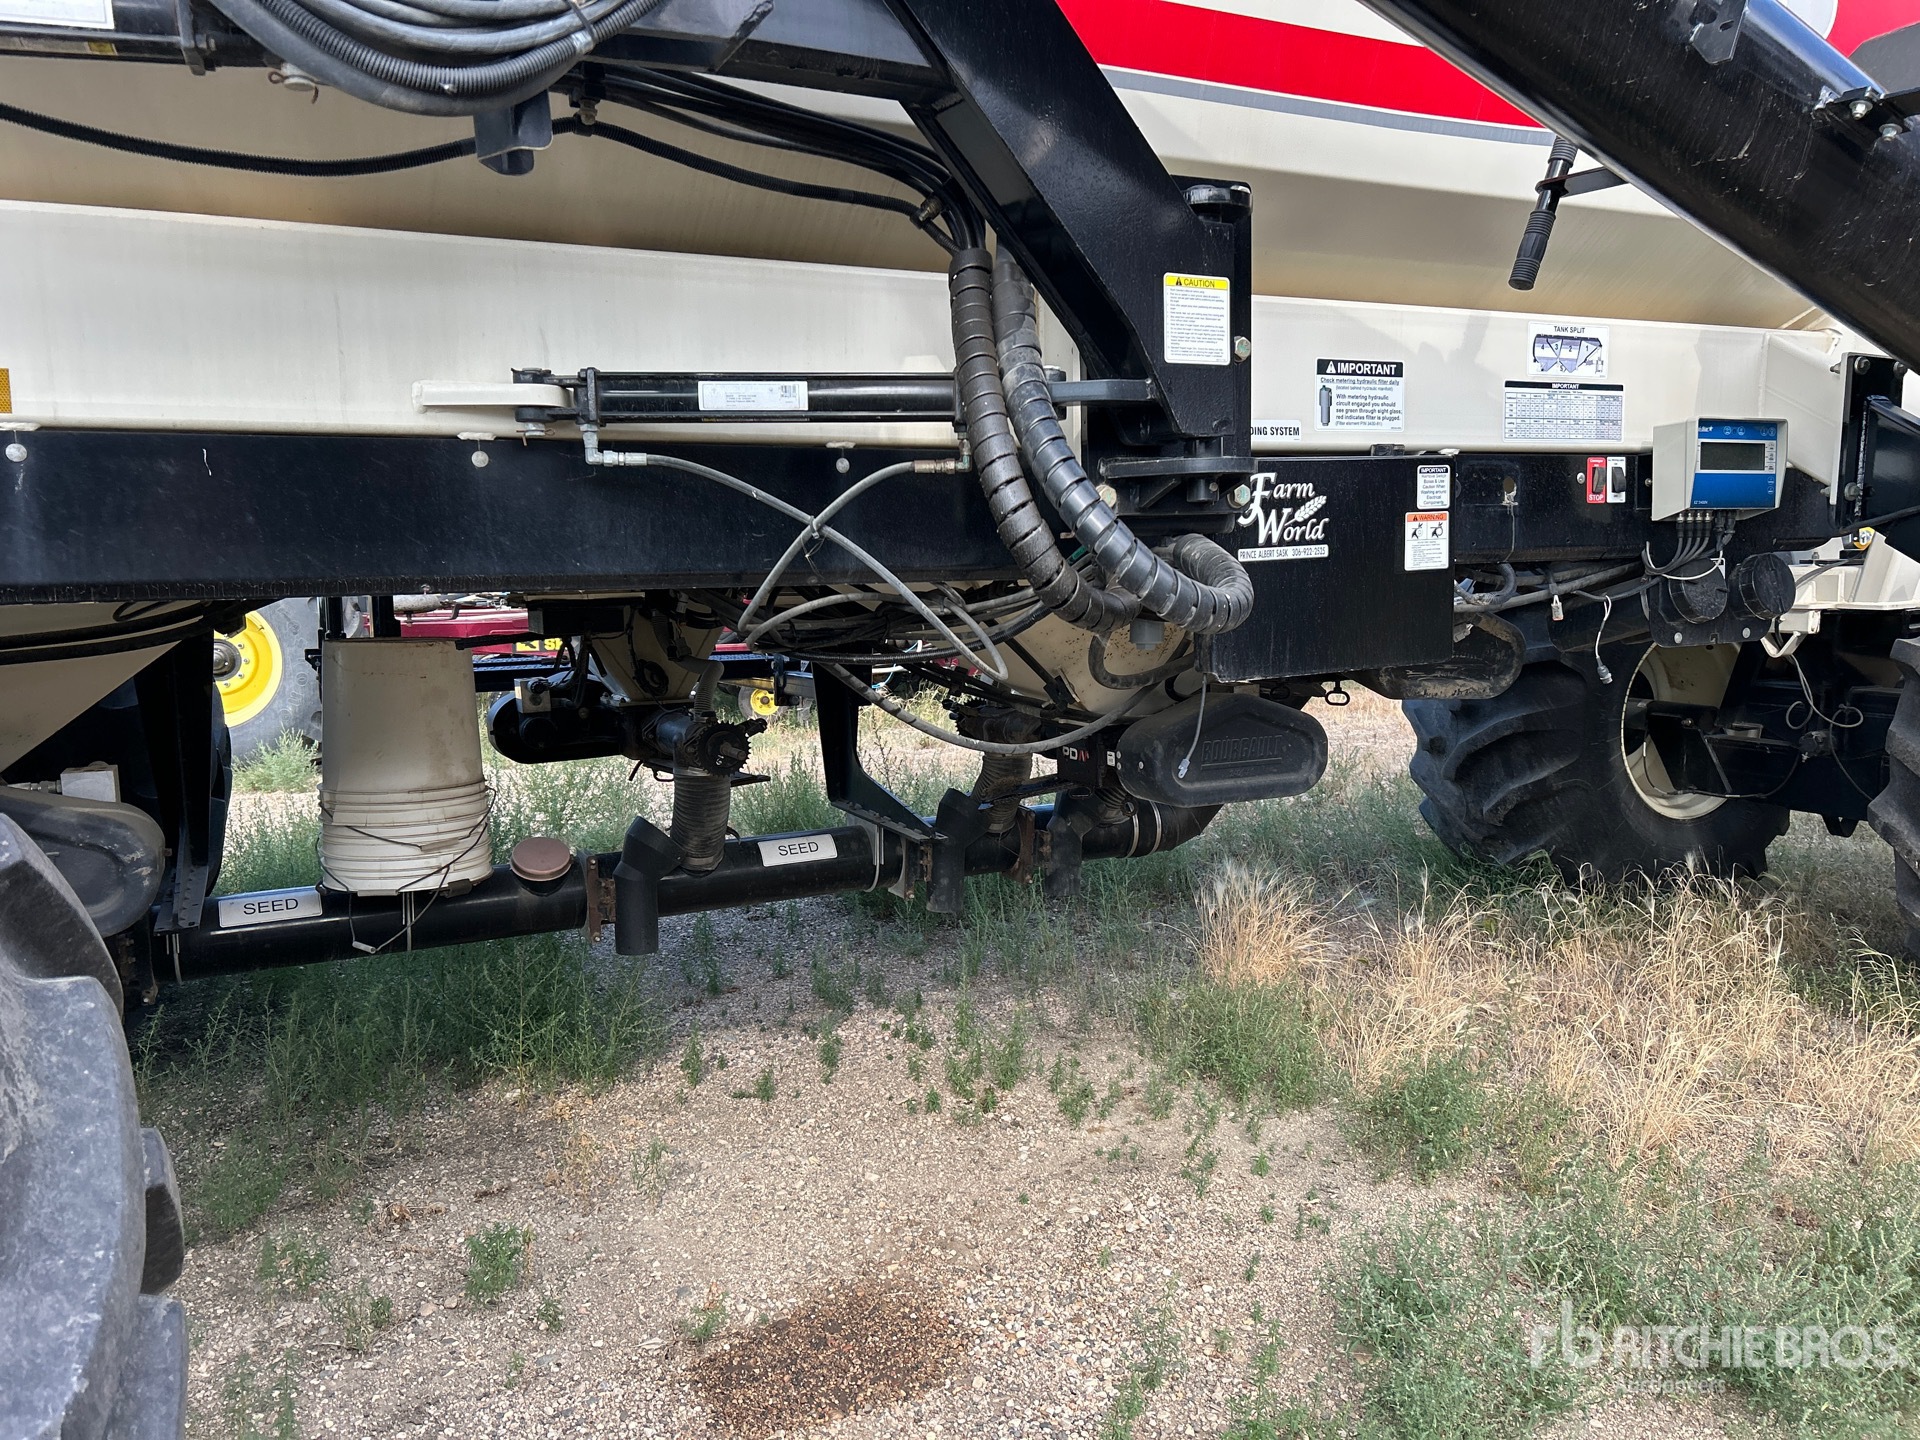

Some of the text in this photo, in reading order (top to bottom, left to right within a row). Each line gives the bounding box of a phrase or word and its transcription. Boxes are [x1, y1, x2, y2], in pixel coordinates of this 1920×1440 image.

[1184, 278, 1215, 288] CAUTION
[1337, 362, 1397, 375] IMPORTANT
[1270, 426, 1299, 436] SYSTEM
[1257, 506, 1330, 545] World
[1240, 550, 1257, 559] PRINCE
[1258, 549, 1274, 558] ALBERT
[1276, 549, 1289, 557] SASK
[1201, 735, 1283, 762] BOURGAULT
[778, 841, 819, 856] SEED
[243, 898, 299, 915] SEED
